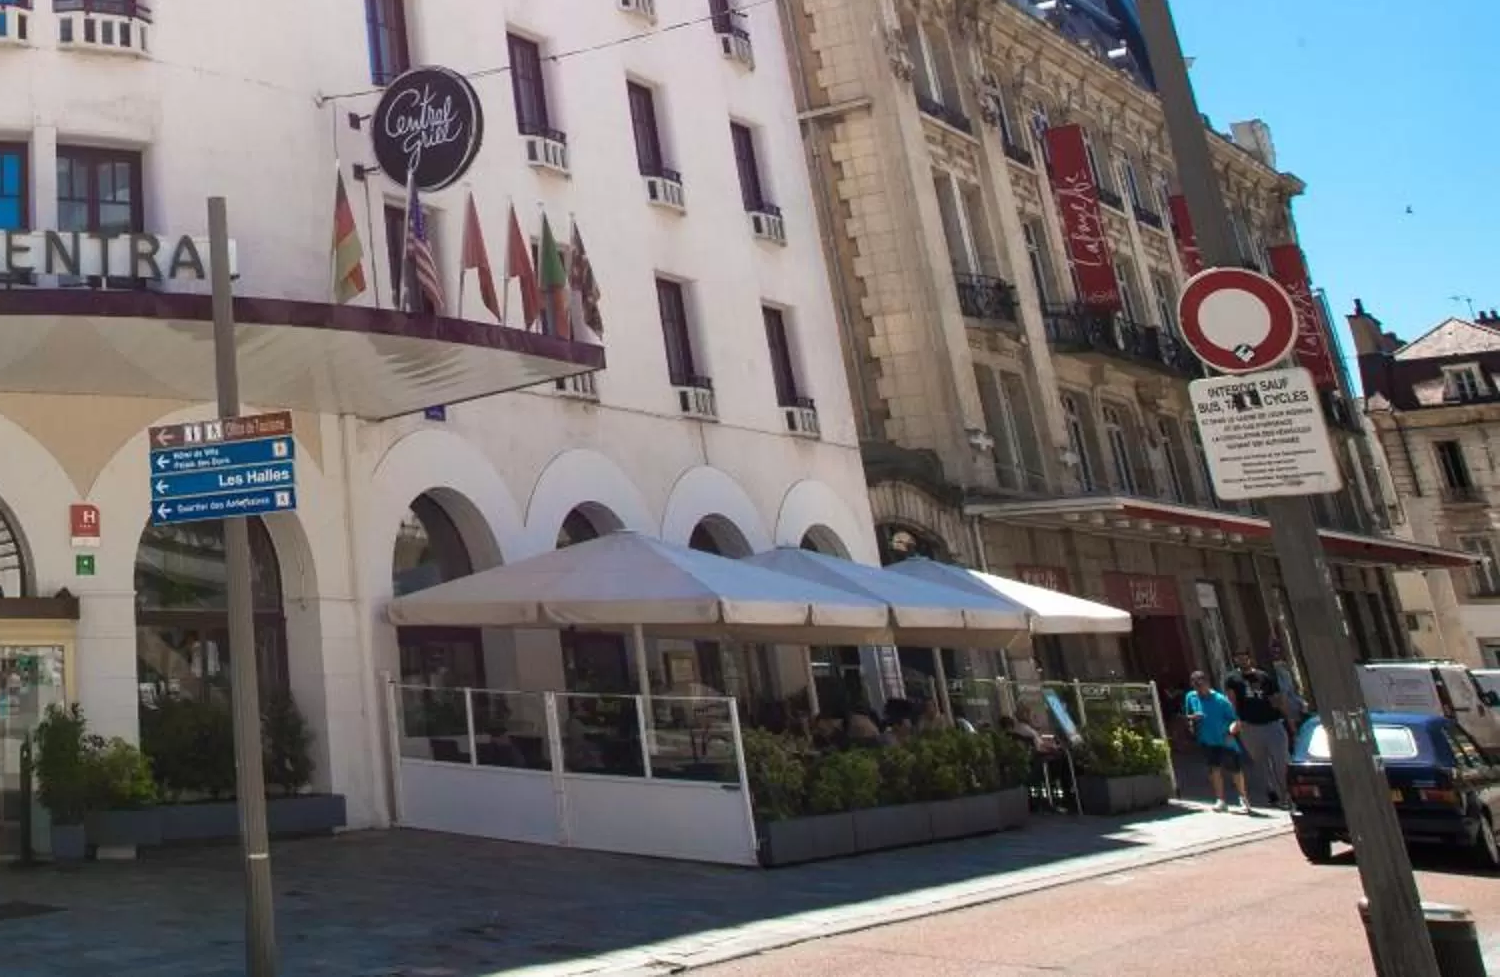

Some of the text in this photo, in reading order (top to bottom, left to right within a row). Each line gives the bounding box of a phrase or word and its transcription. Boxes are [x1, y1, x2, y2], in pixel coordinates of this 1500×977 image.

[385, 83, 458, 137] Central
[1259, 377, 1288, 392] SAUF
[1264, 391, 1309, 406] CYCLES
[218, 469, 290, 488] Les Halles
[83, 510, 96, 524] H
